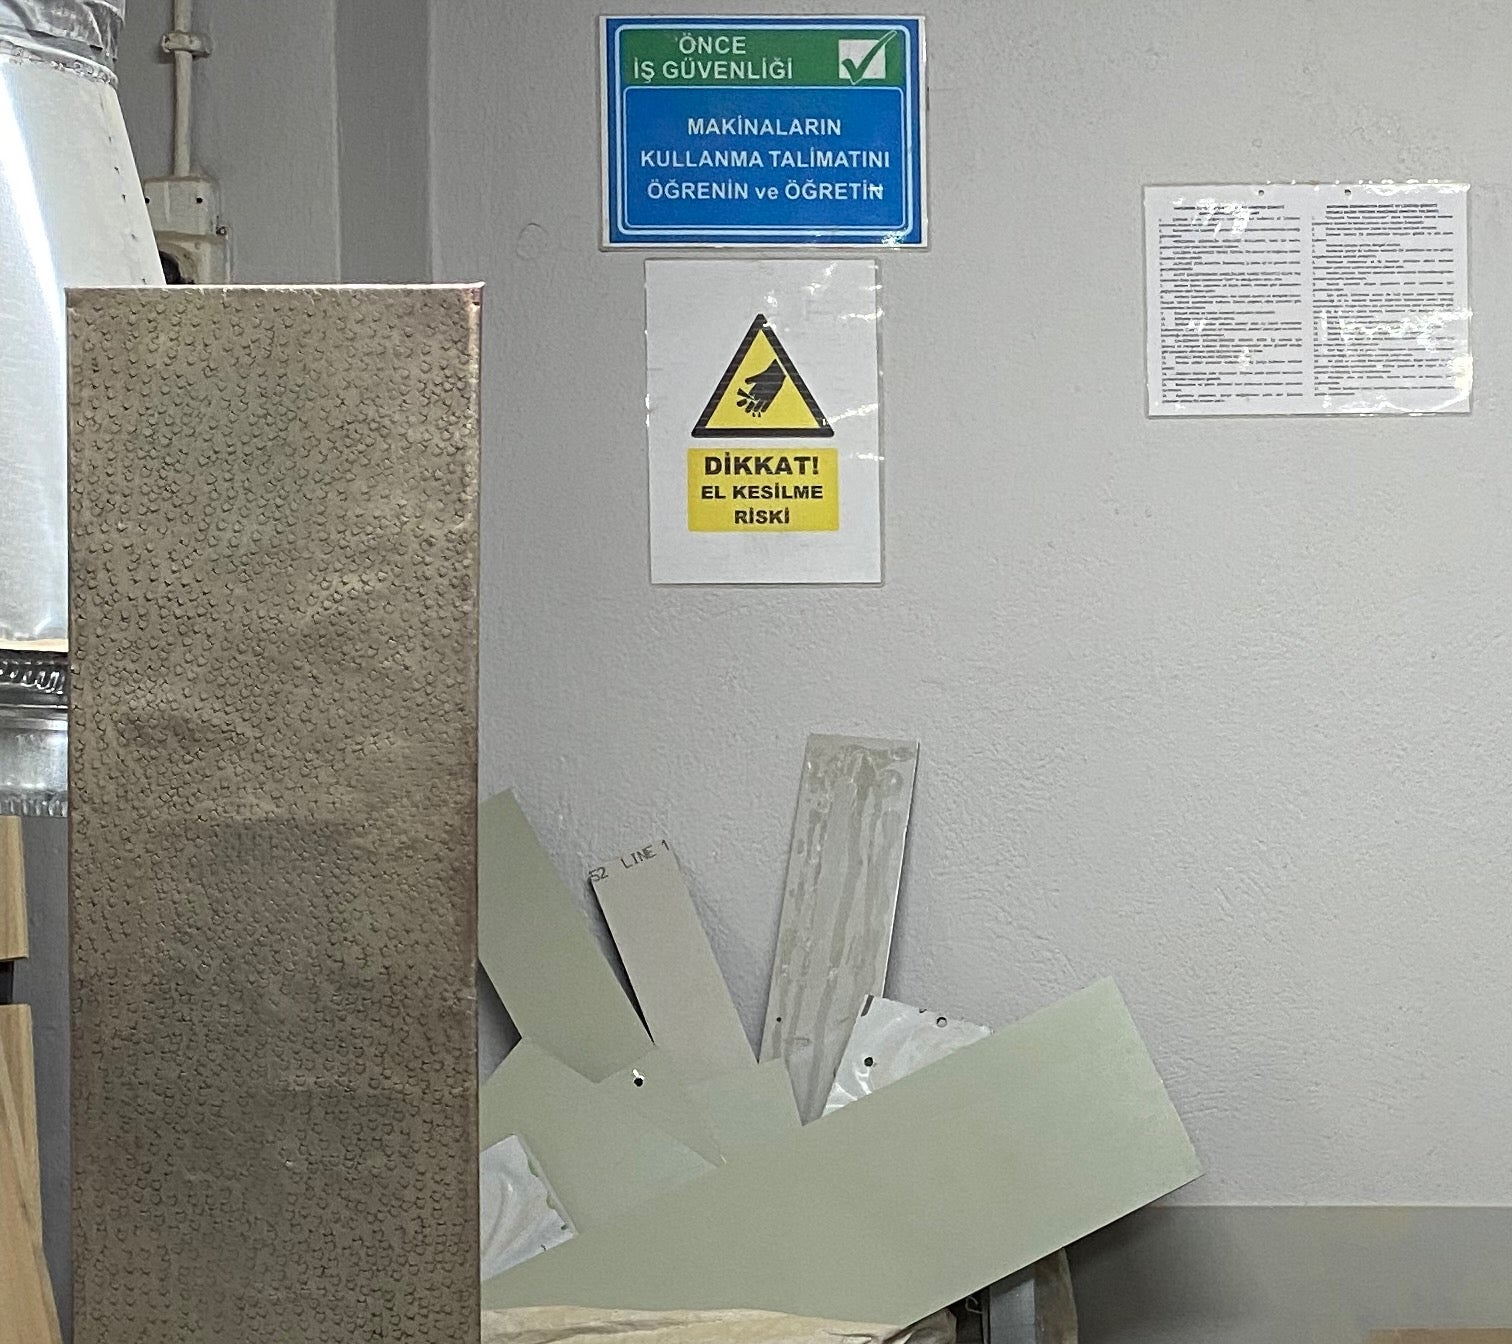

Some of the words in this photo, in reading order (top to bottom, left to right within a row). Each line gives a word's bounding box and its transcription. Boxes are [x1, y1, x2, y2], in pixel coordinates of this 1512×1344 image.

[679, 32, 746, 55] ÖNCE
[634, 57, 655, 84] İŞ
[662, 57, 793, 80] GÜVENLİĞİ
[688, 115, 841, 136] MAKİNALARIN
[641, 150, 764, 168] KULLANMA
[768, 146, 890, 168] TALİMATINI
[647, 178, 748, 199] ÖĞRENİN
[755, 187, 779, 199] ve
[784, 179, 883, 200] ÖĞRETİN
[705, 452, 819, 475] DİKKAT!
[701, 485, 727, 499] EL
[732, 483, 823, 499] KESİLME
[734, 507, 790, 524] RİSKİ
[620, 844, 657, 869] LINE
